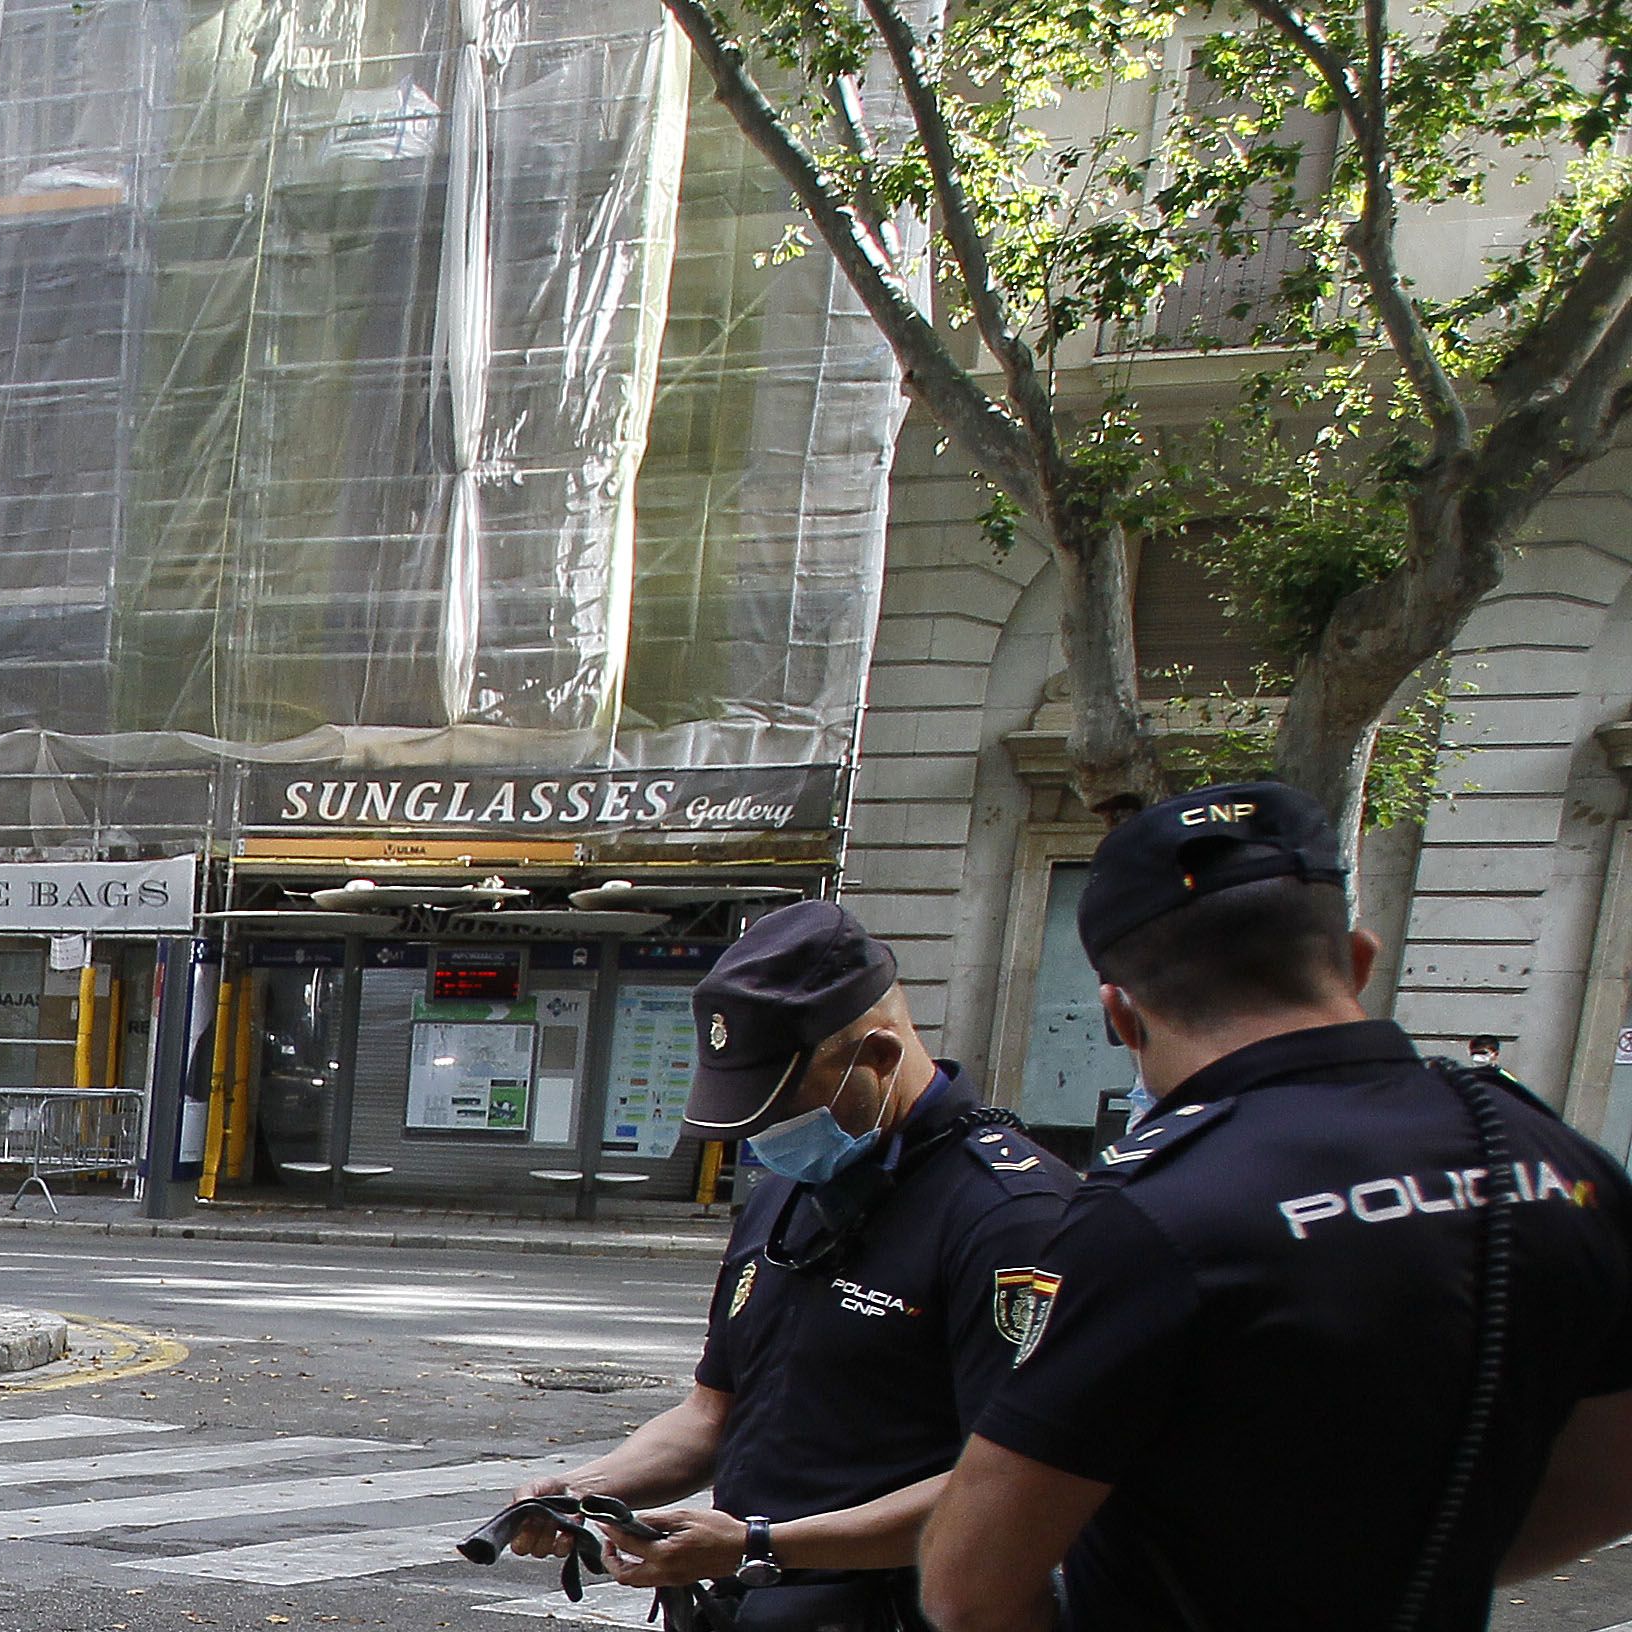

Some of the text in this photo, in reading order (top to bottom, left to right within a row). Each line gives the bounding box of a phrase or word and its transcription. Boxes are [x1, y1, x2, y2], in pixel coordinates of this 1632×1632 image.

[281, 779, 794, 830] SUNGLASSES Gallery
[1180, 801, 1259, 828] CNP
[27, 878, 170, 908] BAGS
[1276, 1160, 1576, 1240] POLICIA
[830, 1278, 905, 1312] POLICIA
[840, 1297, 886, 1317] CNP
